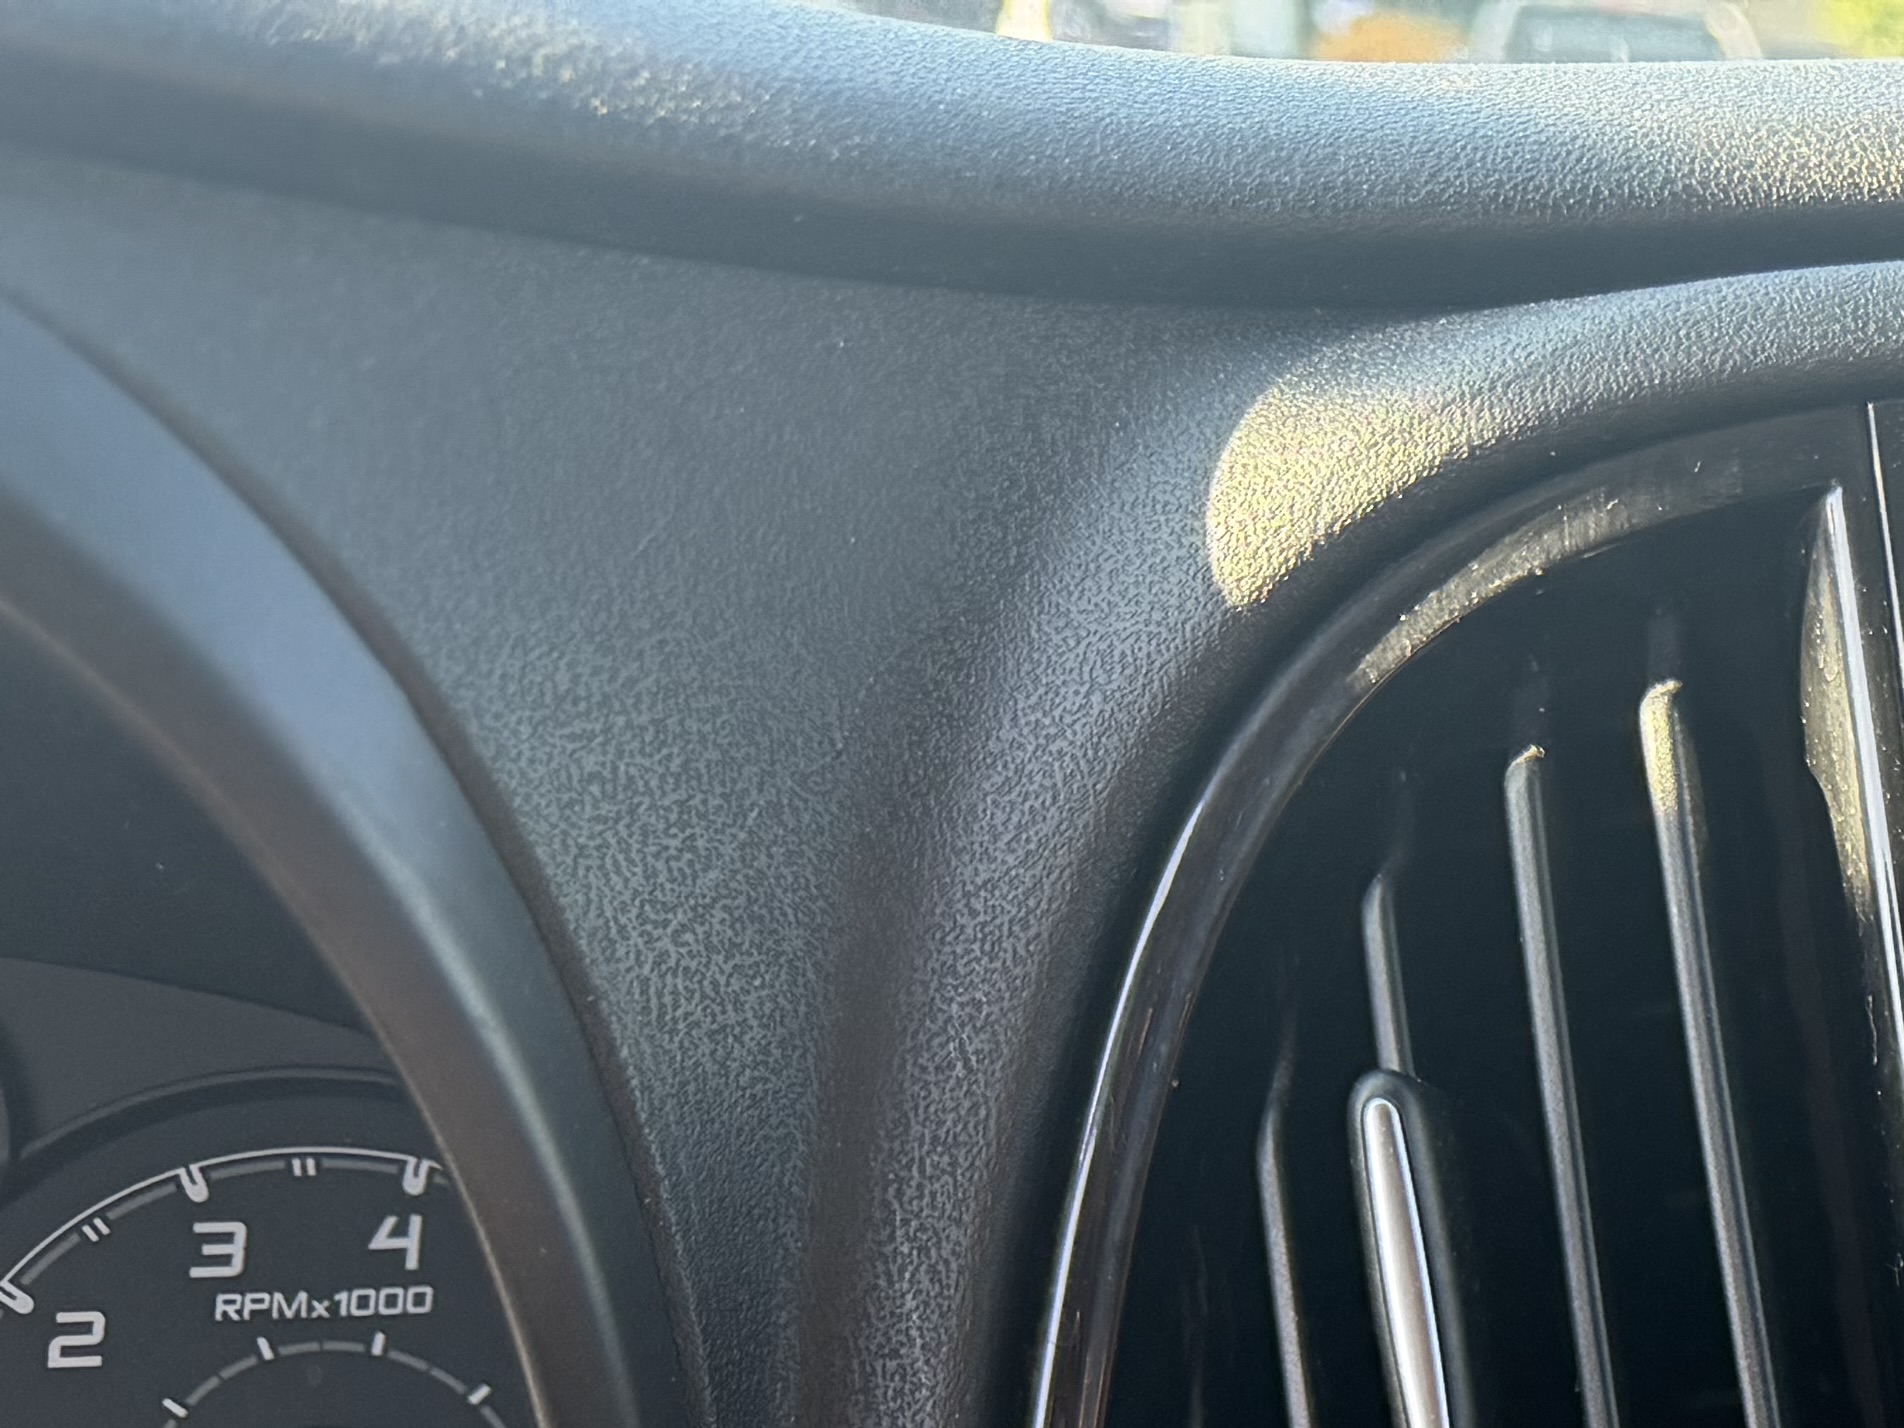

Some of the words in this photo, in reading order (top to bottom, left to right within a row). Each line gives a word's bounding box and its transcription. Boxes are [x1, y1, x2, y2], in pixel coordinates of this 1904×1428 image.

[188, 1220, 248, 1279] 3
[367, 1213, 423, 1272] 4
[213, 1285, 435, 1323] RPMx1000
[46, 1310, 107, 1369] 2
